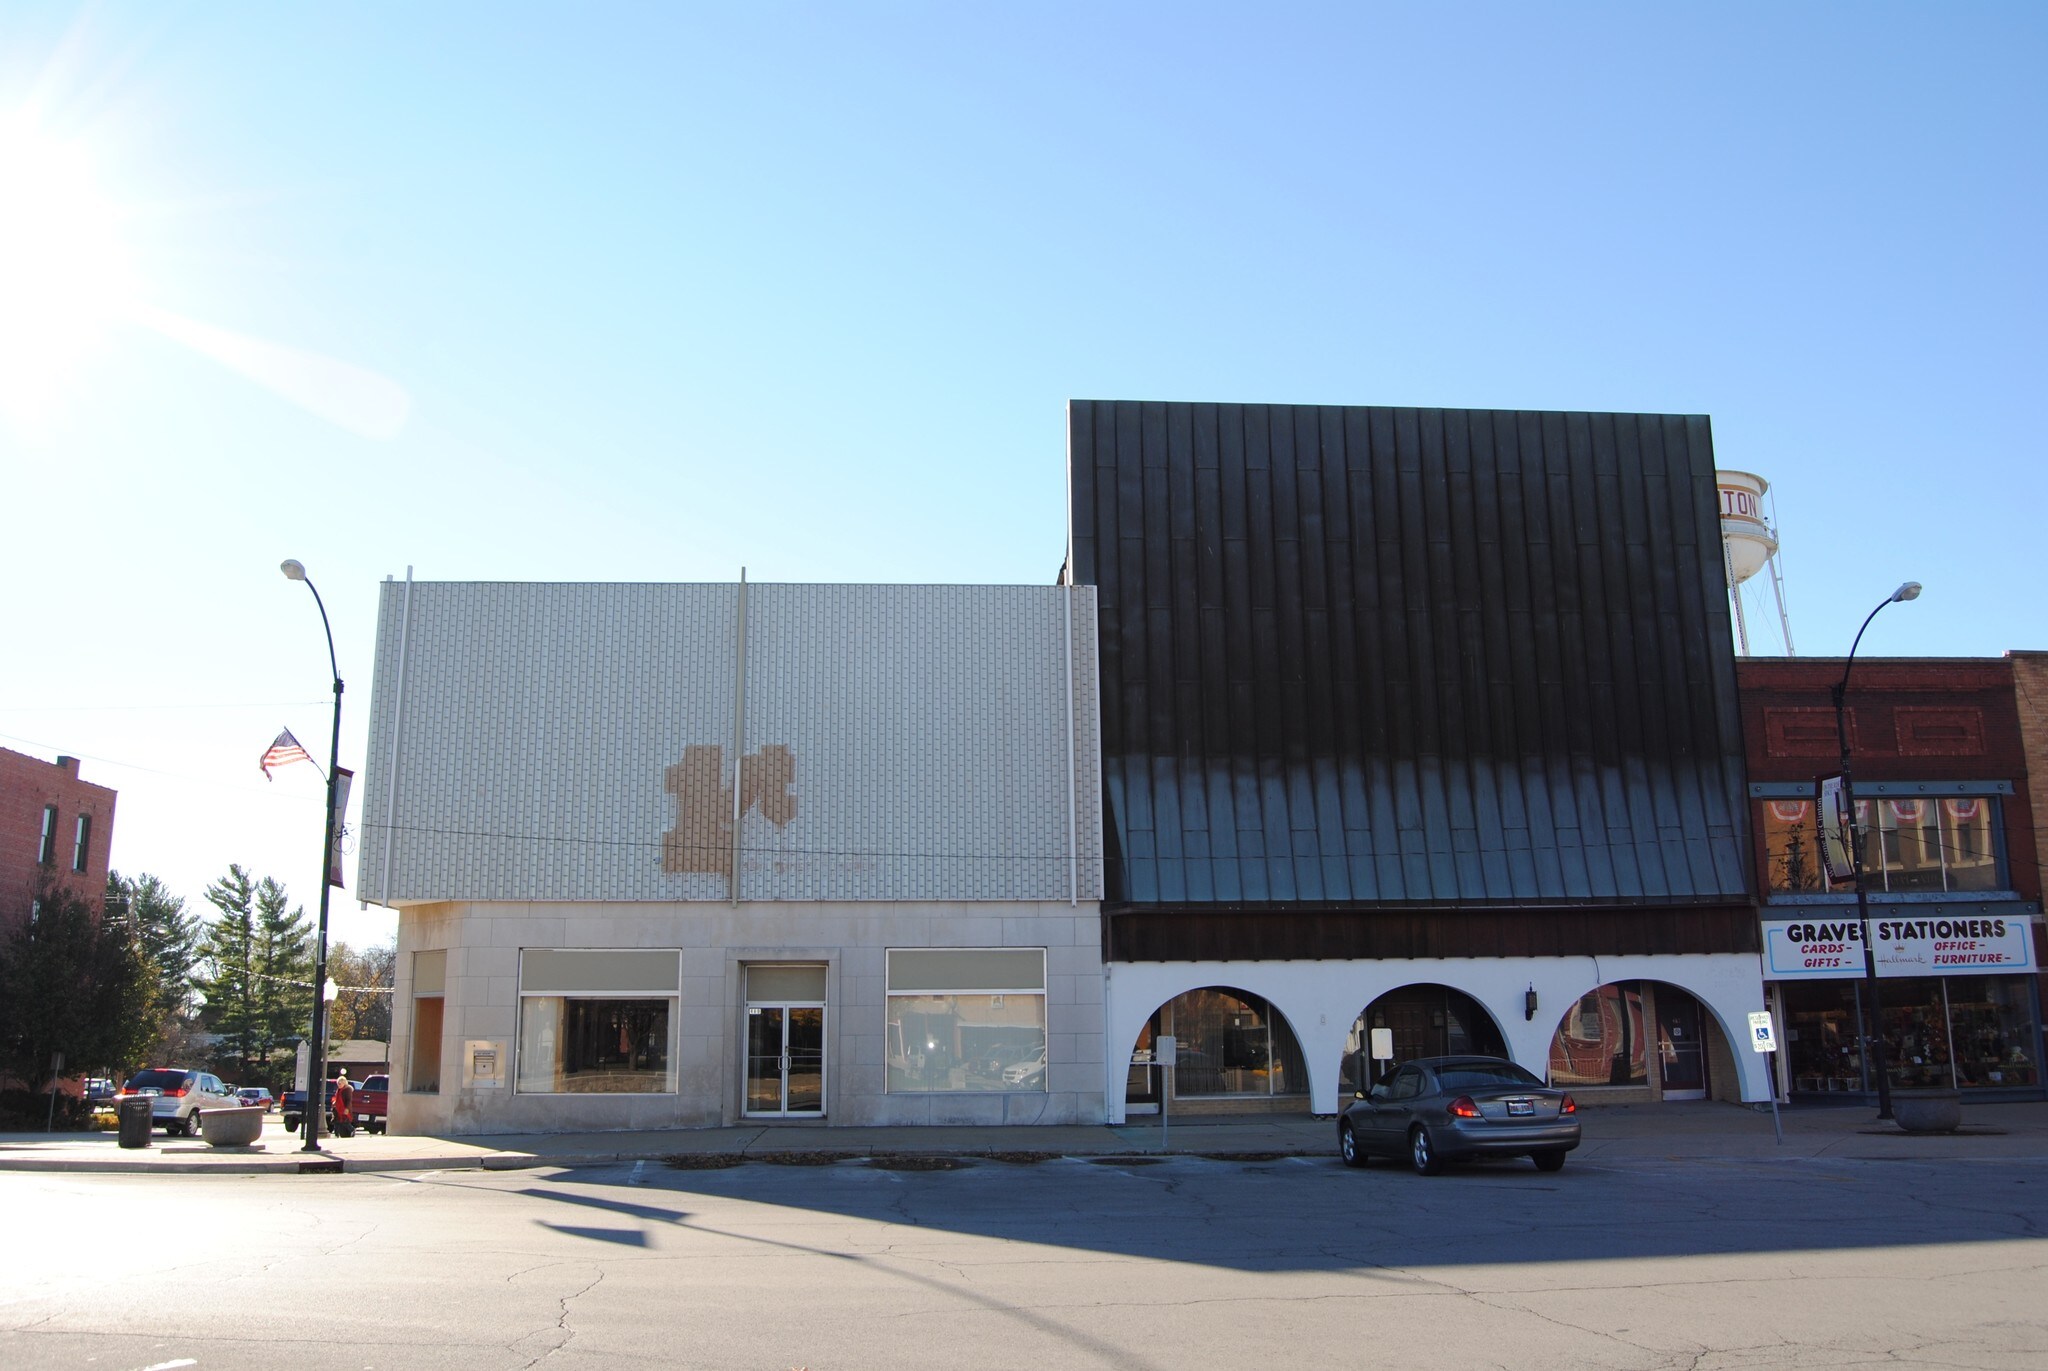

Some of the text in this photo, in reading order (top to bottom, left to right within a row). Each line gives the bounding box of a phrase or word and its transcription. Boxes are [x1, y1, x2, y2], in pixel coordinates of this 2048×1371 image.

[1821, 840, 1835, 878] Welcome
[1878, 919, 2006, 940] STATIONERS
[1877, 953, 1926, 967] Hallmark
